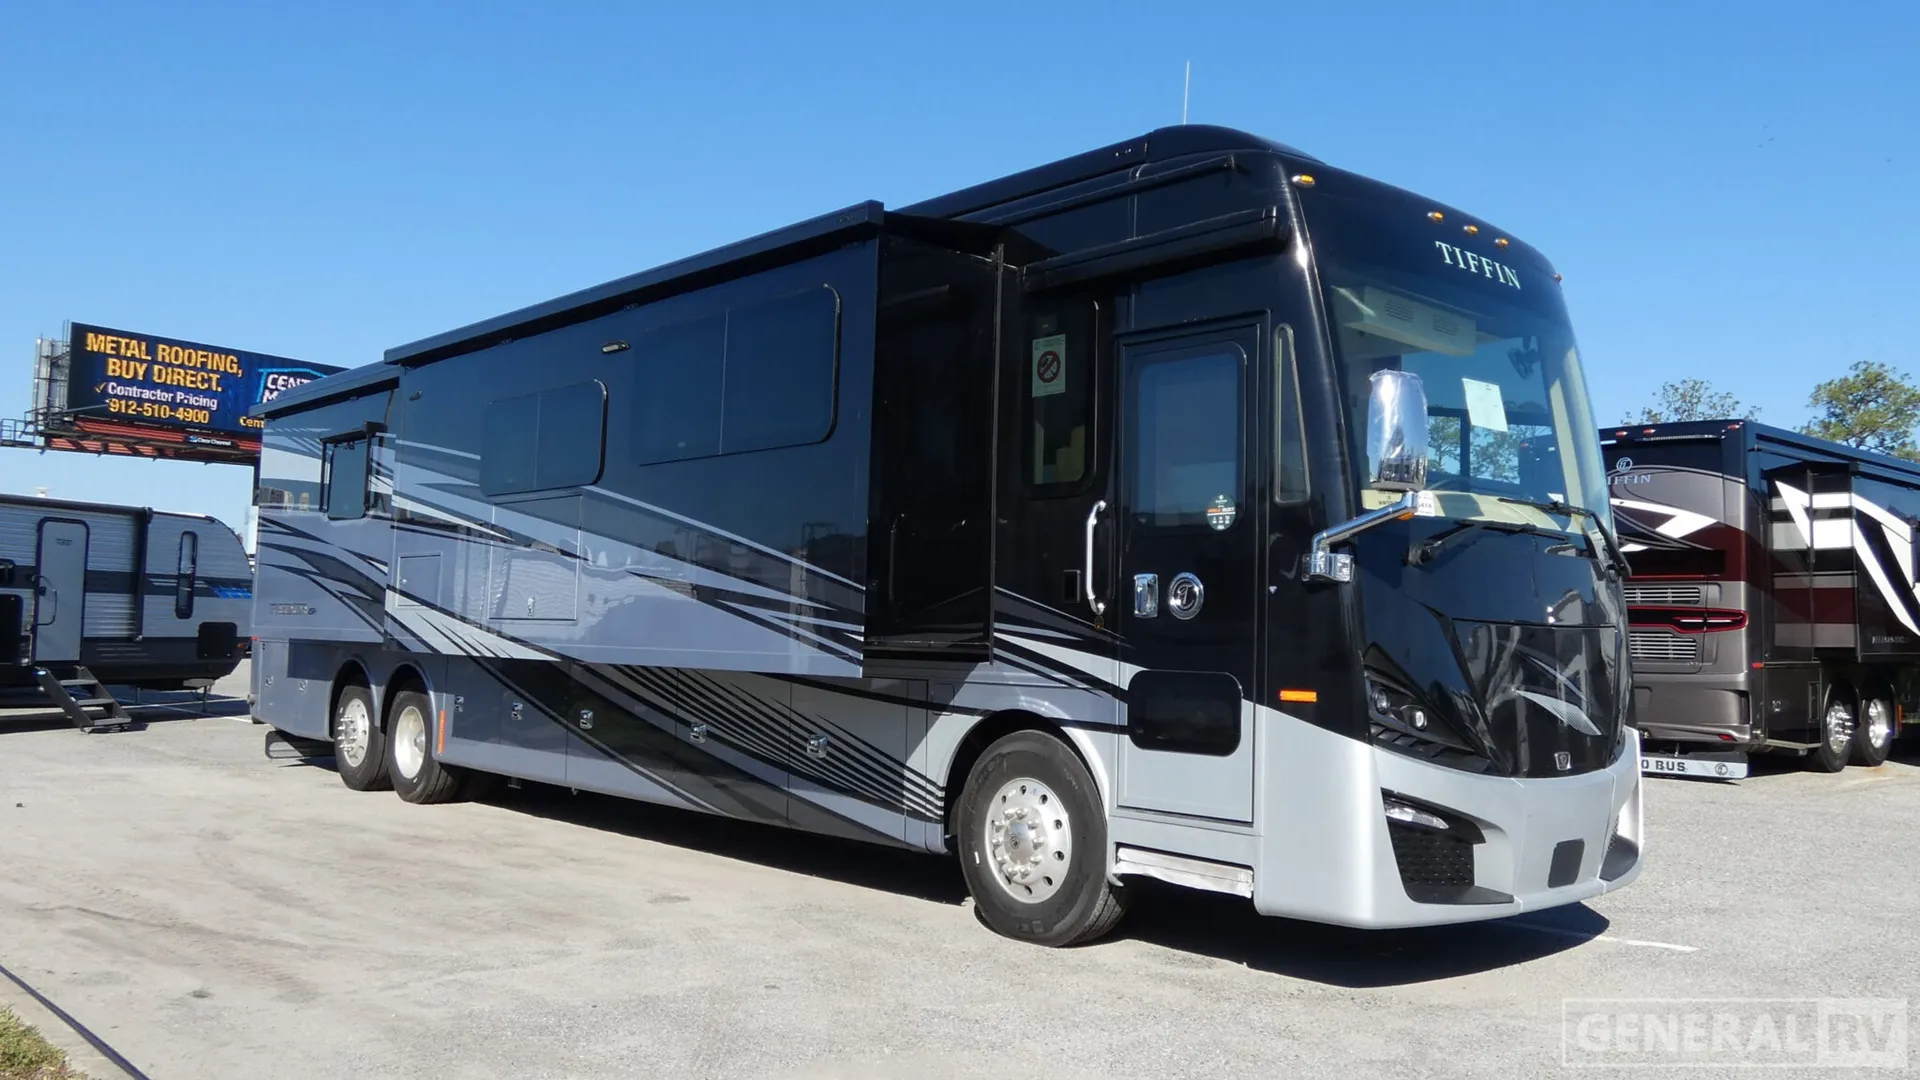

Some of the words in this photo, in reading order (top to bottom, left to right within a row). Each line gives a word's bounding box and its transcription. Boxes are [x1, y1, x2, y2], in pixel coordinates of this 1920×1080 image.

[1434, 240, 1521, 290] TIFFIN
[85, 332, 152, 361] METAL
[156, 344, 243, 377] ROOFING,
[107, 358, 148, 381] BUY
[153, 365, 223, 392] DIRECT.
[267, 374, 312, 391] CEN
[108, 382, 174, 402] Contractor
[176, 391, 218, 411] Pricing
[108, 398, 210, 424] 912-510-4900
[1607, 474, 1651, 485] IFFIN
[1656, 760, 1686, 772] BUS
